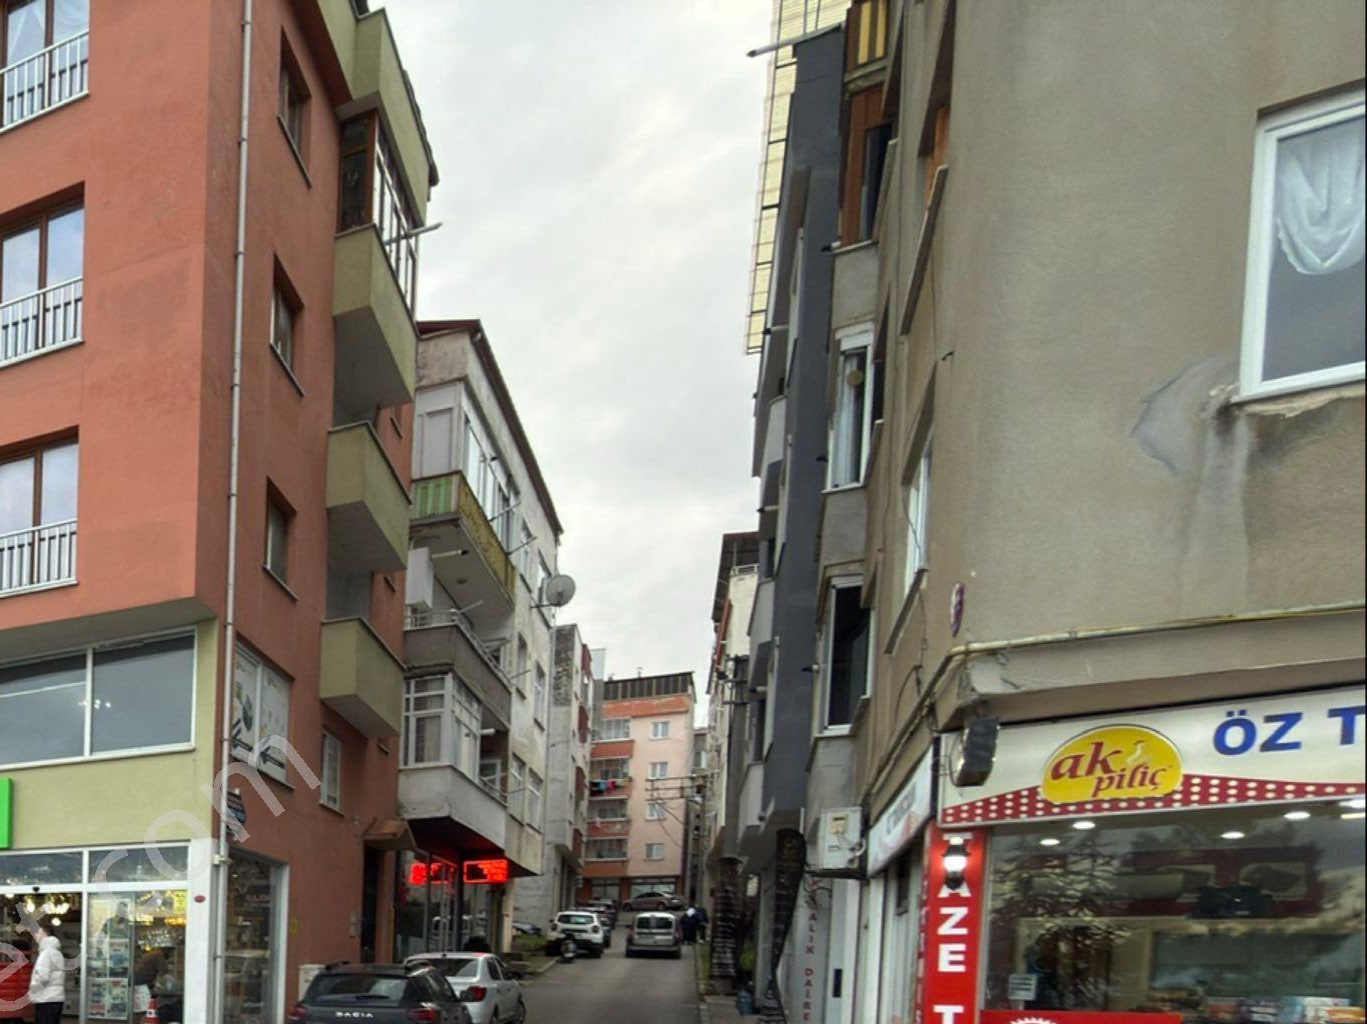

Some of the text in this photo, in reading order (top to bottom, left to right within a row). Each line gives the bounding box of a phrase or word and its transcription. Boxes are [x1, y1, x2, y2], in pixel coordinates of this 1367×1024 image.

[1213, 709, 1303, 756] ÖZ
[1050, 741, 1124, 780] ak
[1091, 763, 1168, 798] piliç
